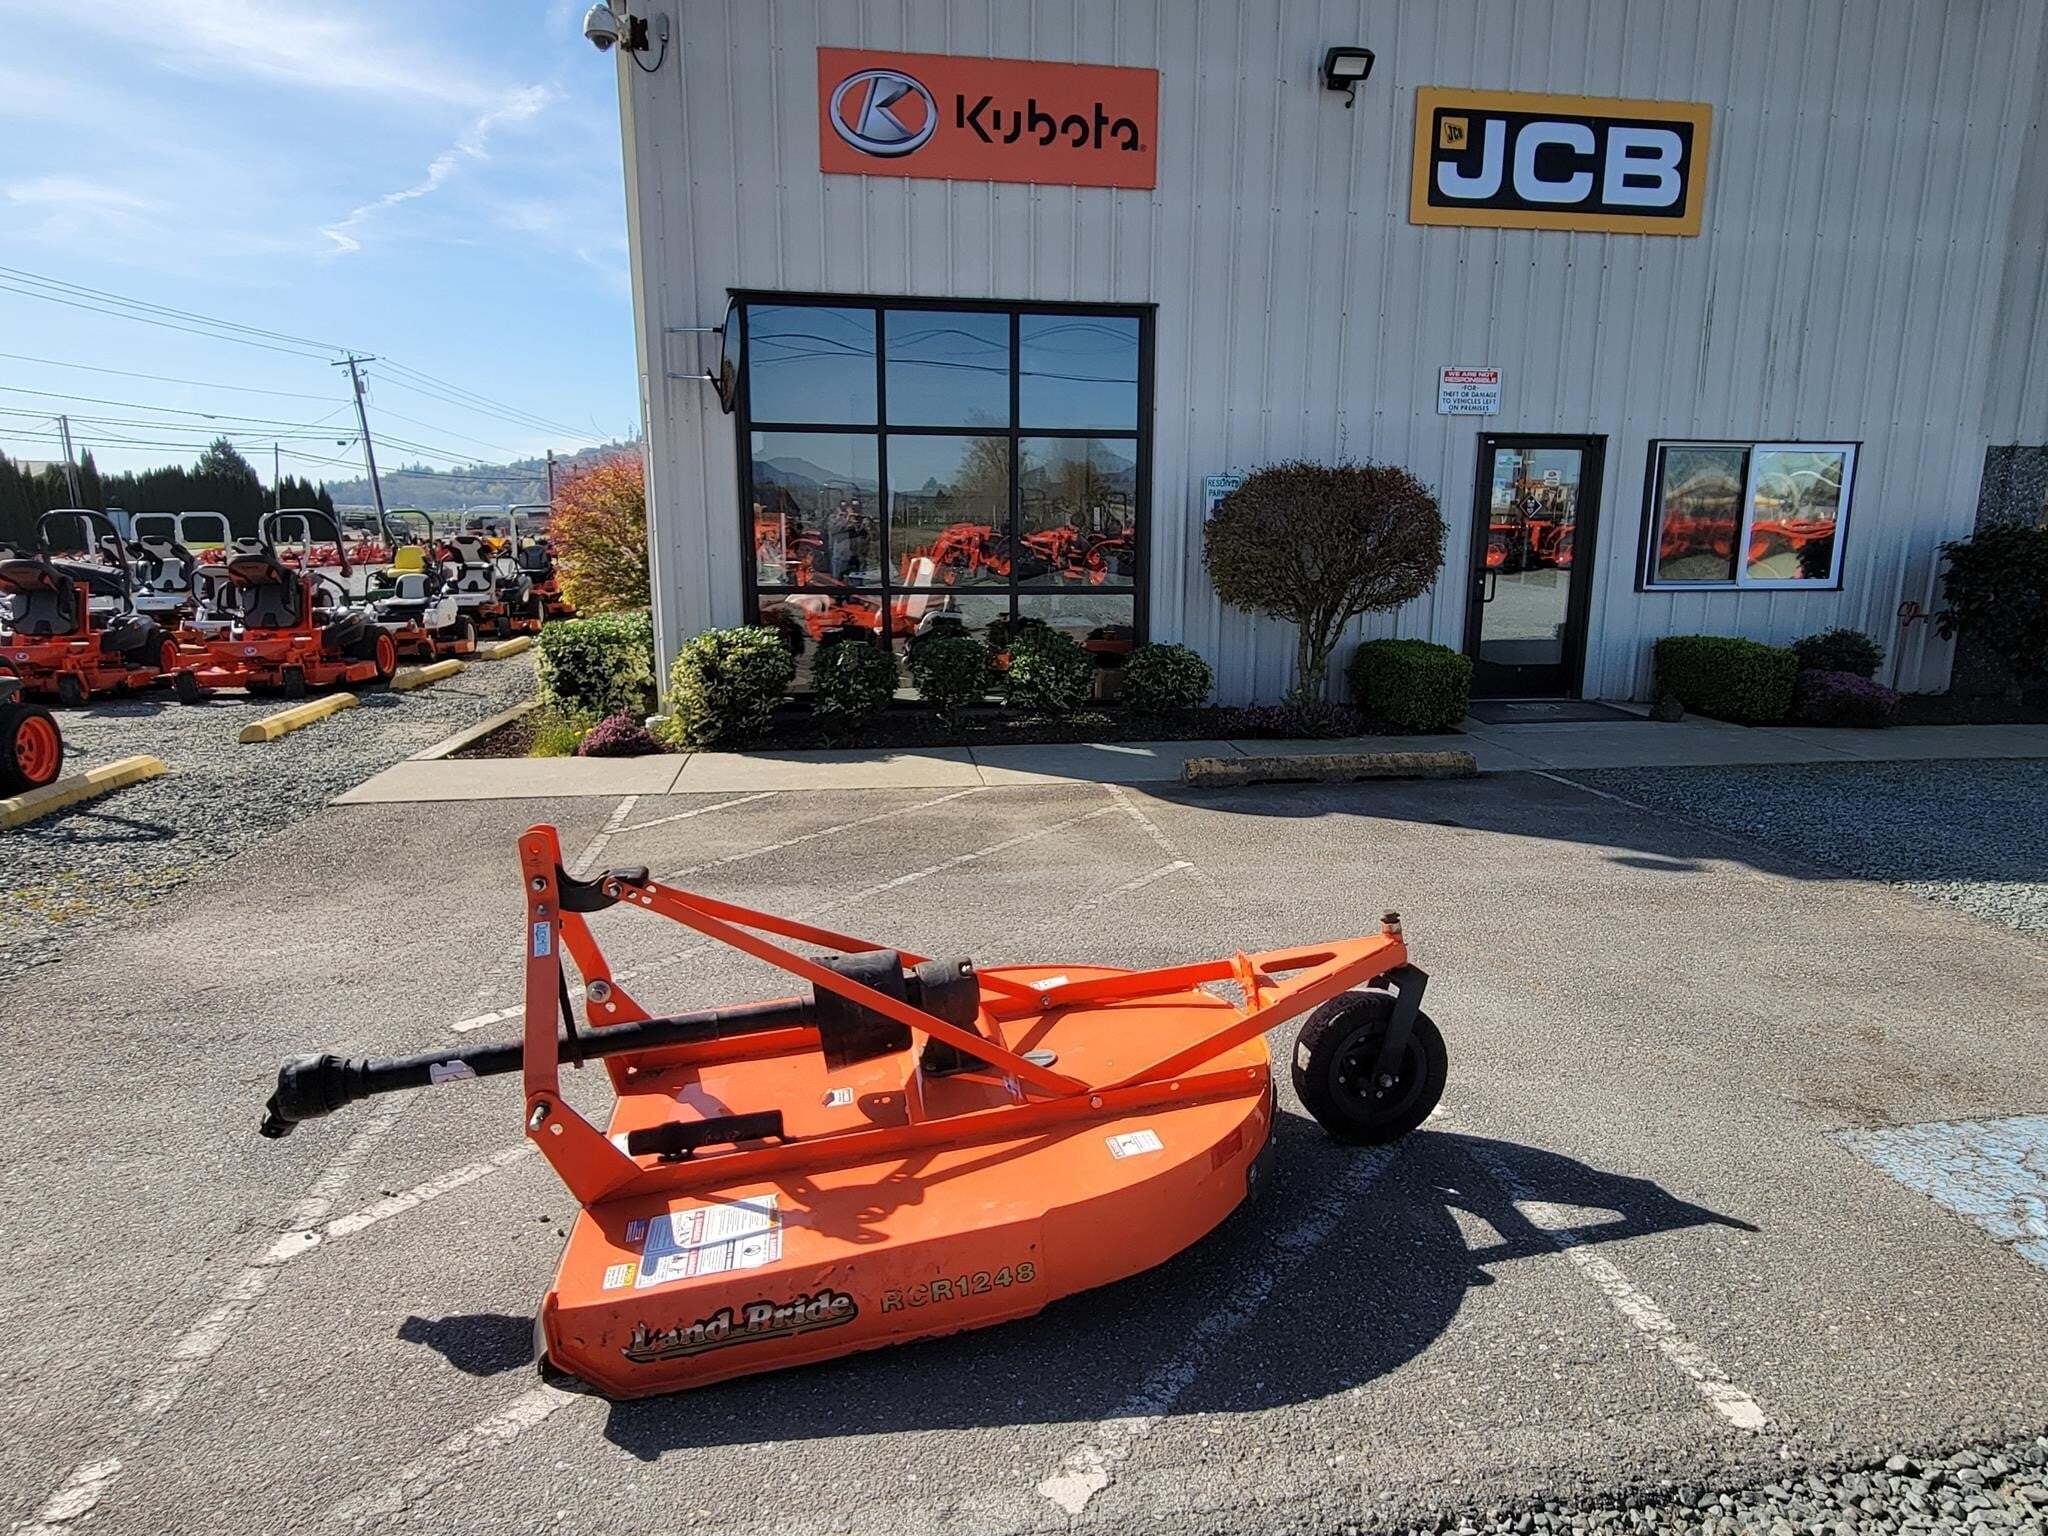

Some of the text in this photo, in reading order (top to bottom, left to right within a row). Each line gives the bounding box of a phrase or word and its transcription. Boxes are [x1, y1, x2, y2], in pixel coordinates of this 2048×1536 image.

[956, 94, 1140, 151] Kubota
[1437, 119, 1683, 207] JCB
[880, 1262, 1036, 1313] RCR1248
[631, 1291, 856, 1352] Land Pride
